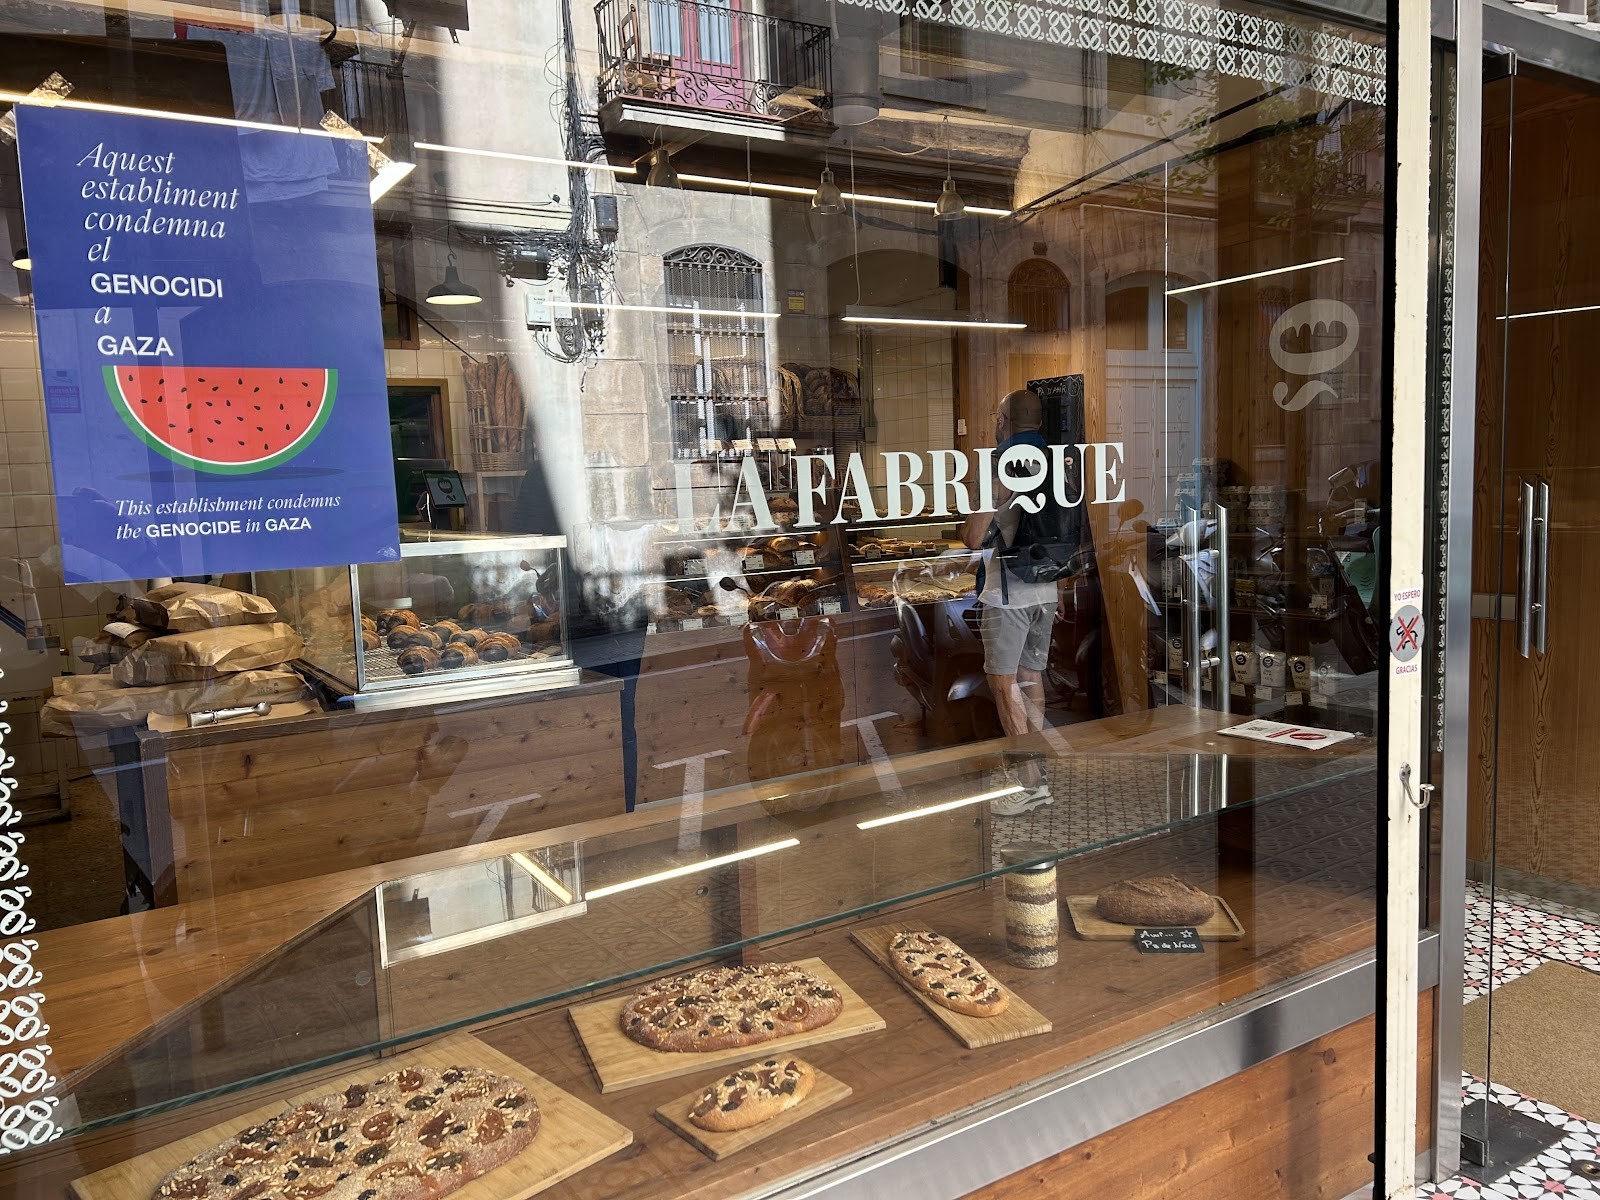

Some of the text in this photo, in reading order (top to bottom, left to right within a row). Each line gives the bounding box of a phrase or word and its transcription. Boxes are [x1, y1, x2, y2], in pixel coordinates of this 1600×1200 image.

[76, 142, 175, 177] Aquest
[81, 177, 239, 209] establiment
[84, 208, 226, 239] condemna
[87, 236, 111, 262] el
[90, 272, 223, 298] GENOCIDI
[94, 306, 112, 324] a
[97, 335, 174, 356] GAZA
[667, 441, 1127, 534] LA FABRIQUE
[115, 493, 342, 517] This establishment condemns
[116, 517, 313, 540] the GENOCIDE in GAZA
[1402, 590, 1421, 600] ESPERO
[1396, 664, 1418, 674] GRACIAS
